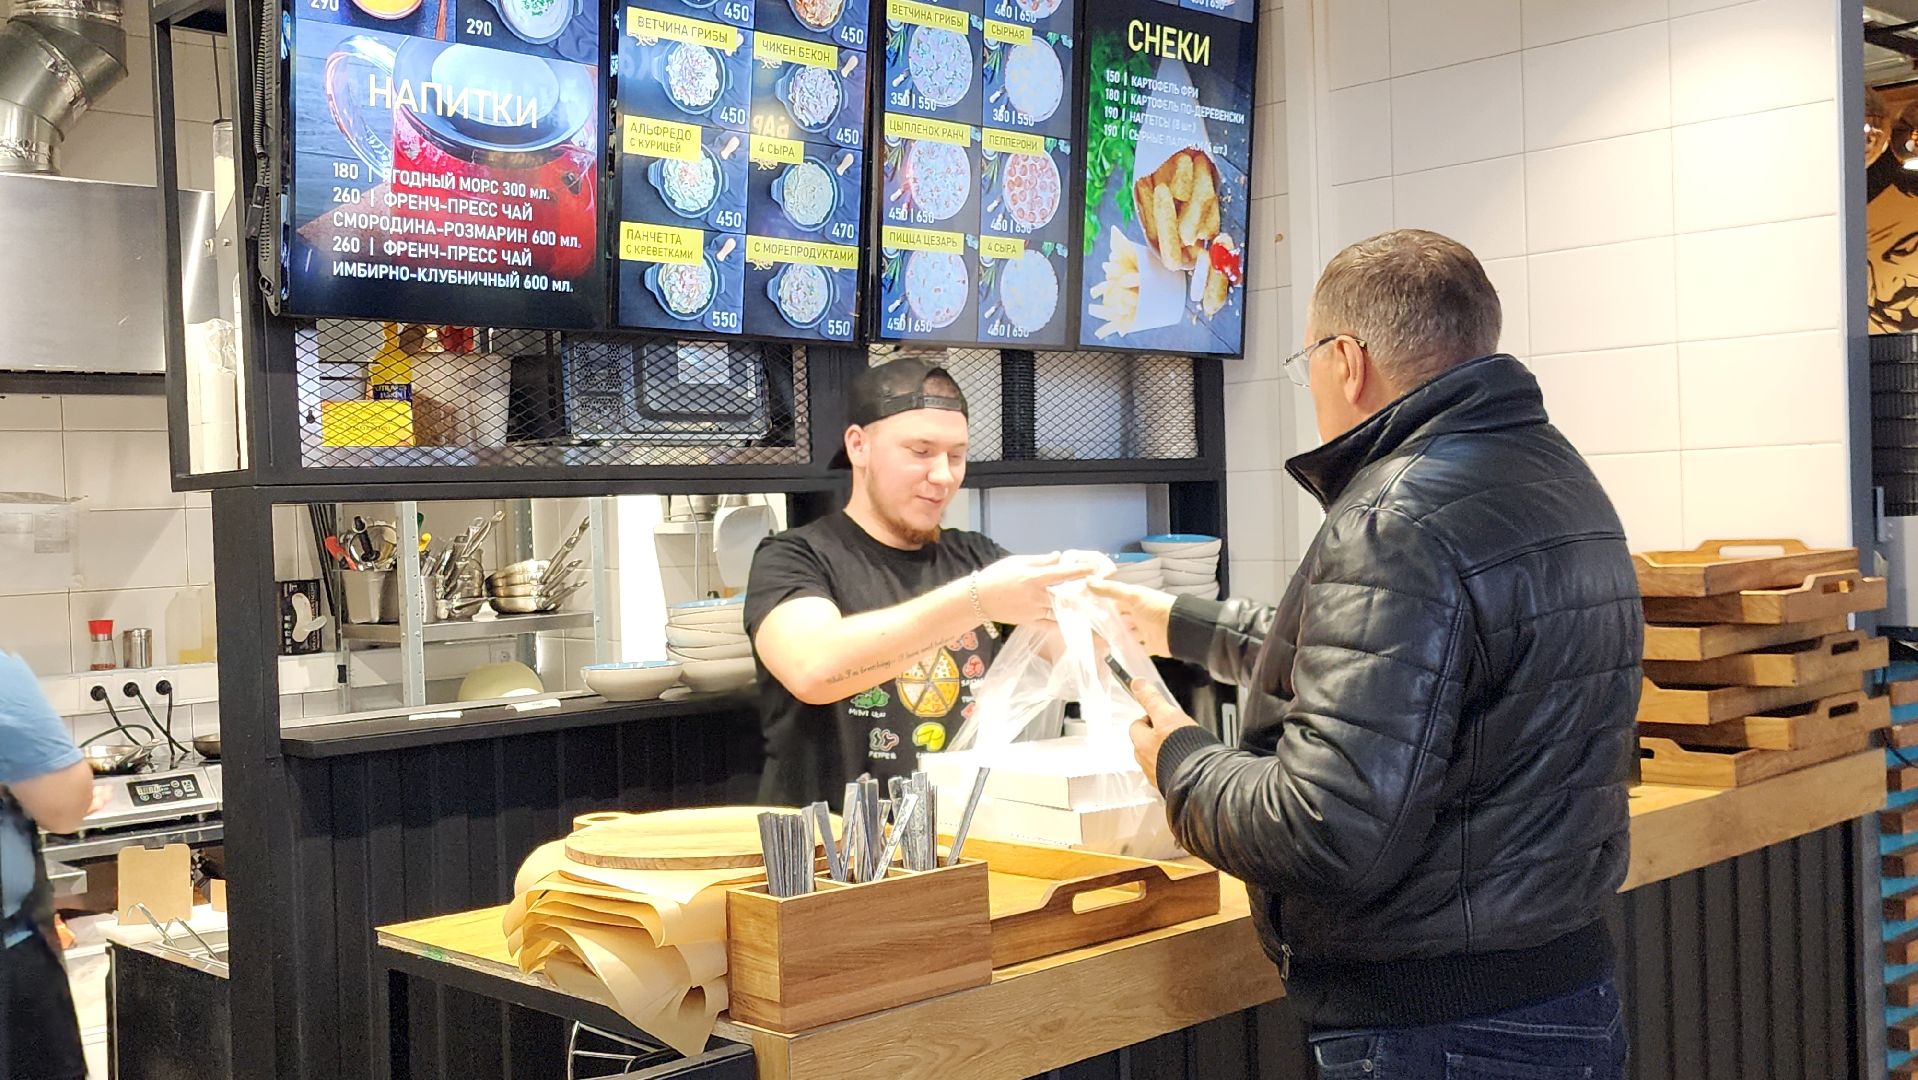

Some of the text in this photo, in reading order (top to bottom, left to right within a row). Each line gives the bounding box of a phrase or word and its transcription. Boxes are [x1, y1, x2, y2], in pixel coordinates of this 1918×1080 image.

[723, 4, 749, 22] 450
[891, 3, 964, 28] ВЕТЧИНА ГРИБЫ
[466, 18, 492, 37] 290
[637, 15, 728, 44] ВЕТЧИНА ГРИБЫ
[840, 25, 864, 45] 450
[991, 24, 1025, 40] СЫРНАЯ
[761, 40, 831, 63] ЧИКЕН БЕКОН
[1127, 19, 1211, 67] СНЕКИ
[1105, 69, 1199, 100] 150 КАРТОФЕЛЬ ФРИ
[368, 73, 539, 129] НАПИТКИ
[918, 95, 937, 112] 550
[1104, 87, 1245, 125] 180 КАРТОФЕЛЬ ПО-ДЕРЕВЕНСКИ
[719, 106, 746, 125] 450
[1016, 112, 1035, 127] 550
[1103, 105, 1119, 120] 190
[630, 122, 692, 141] АЛЬФРЕДО
[836, 126, 860, 145] 450
[889, 120, 965, 141] ЦЫПЛЕНОК РАНЧ
[1102, 124, 1118, 138] 190
[630, 138, 682, 154] С КУРИЦЕЙ
[758, 141, 795, 158] 4 СЫРА
[988, 134, 1038, 150] ПЕППЕРОНИ
[332, 162, 551, 201] 180 ЯГОДНЫЙ МОРС 300 мл.
[332, 187, 533, 221] 260 ФРЕНЧ-ПРЕСС ЧАЙ
[715, 210, 742, 229] 450
[916, 209, 935, 224] 650
[332, 211, 582, 249] СМОРОДИНА-РОЗМАРИН 600 мл.
[626, 229, 682, 246] ПАНЧЕТТА
[831, 223, 855, 239] 470
[889, 231, 958, 248] ПИЦЦА ЦЕЗАРЬ
[332, 236, 533, 267] 260 ФРЕНЧ-ПРЕСС ЧАЙ
[626, 244, 694, 260] С КРЕВЕТКАМИ
[754, 242, 855, 263] С МОРЕПРОДУКТАМИ
[987, 242, 1017, 255] 4 СЫРА
[332, 261, 574, 293] ИМБИРНО-КЛУБНИЧНЫЙ 600 мл.
[712, 311, 738, 328] 550
[827, 319, 851, 336] 550
